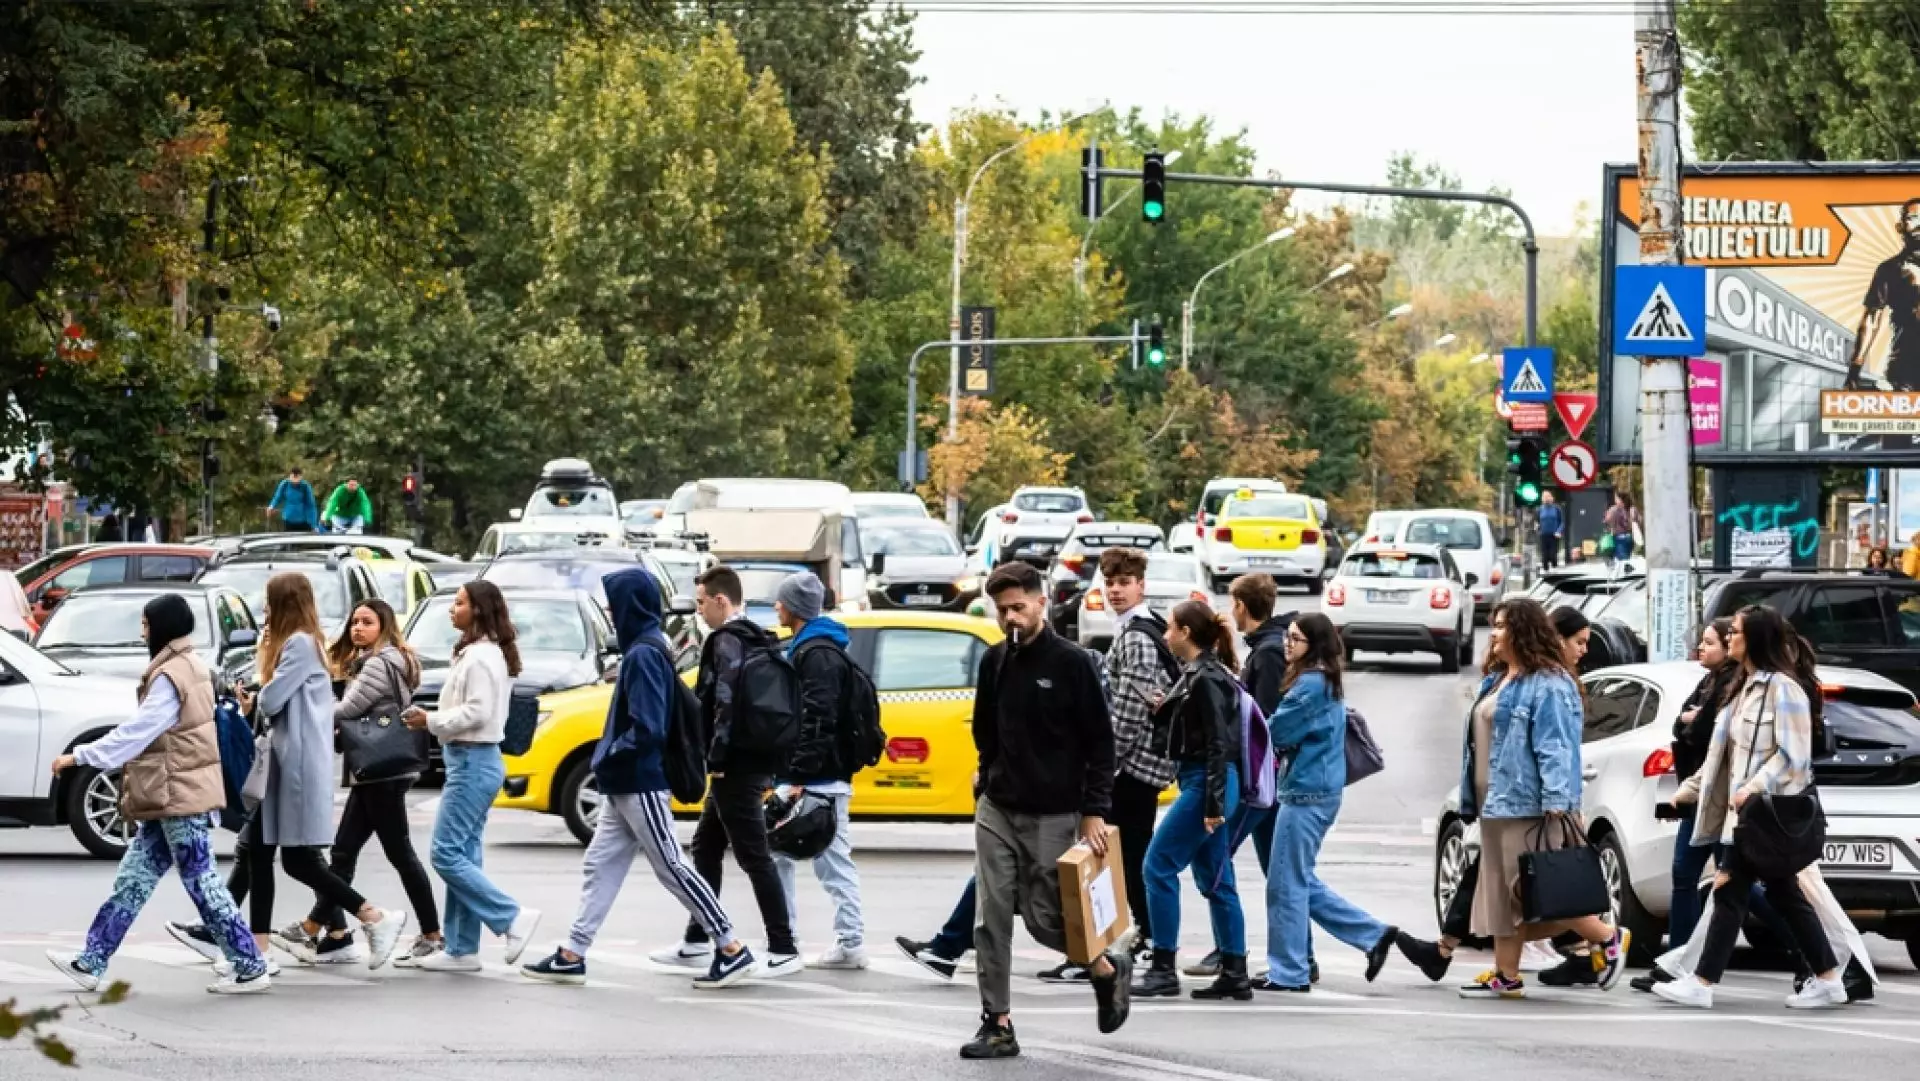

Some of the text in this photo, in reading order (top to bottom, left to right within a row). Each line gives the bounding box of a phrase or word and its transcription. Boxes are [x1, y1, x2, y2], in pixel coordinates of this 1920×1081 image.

[1682, 197, 1792, 224] HEMAREA
[1684, 226, 1830, 258] ROIECTULUI
[1833, 754, 1894, 763] LVO
[1822, 844, 1885, 862] 07 WIS
